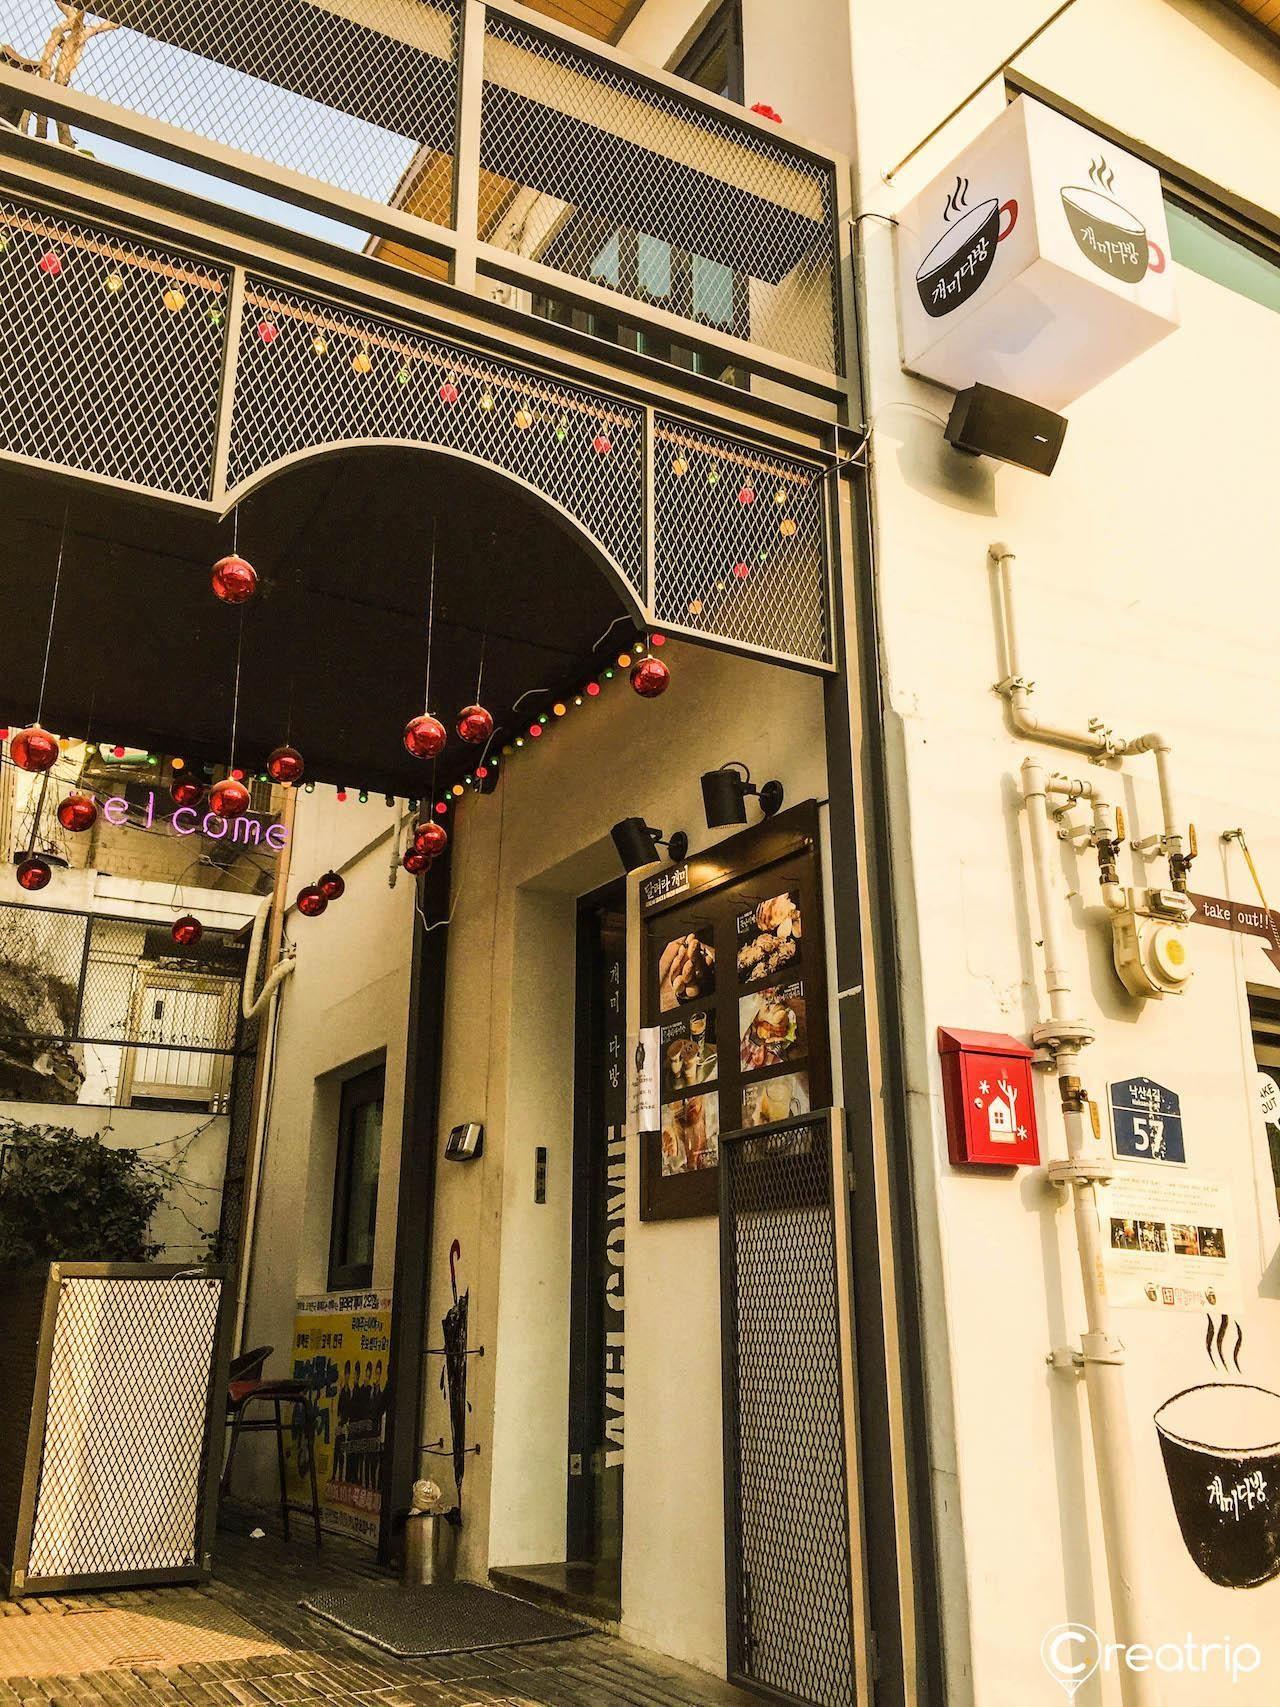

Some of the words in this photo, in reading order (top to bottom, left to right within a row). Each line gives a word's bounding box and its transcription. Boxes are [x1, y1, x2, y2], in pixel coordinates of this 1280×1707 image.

[1081, 226, 1139, 265] 개미다방
[931, 236, 990, 304] 개미다방
[69, 790, 290, 850] elcome
[671, 863, 689, 887] 개미
[1203, 902, 1231, 920] take
[1237, 912, 1269, 930] out!!
[608, 1034, 621, 1089] 다방
[1261, 1097, 1277, 1114] OUT
[1132, 1116, 1164, 1157] 57
[1206, 1470, 1268, 1522] 개미다방
